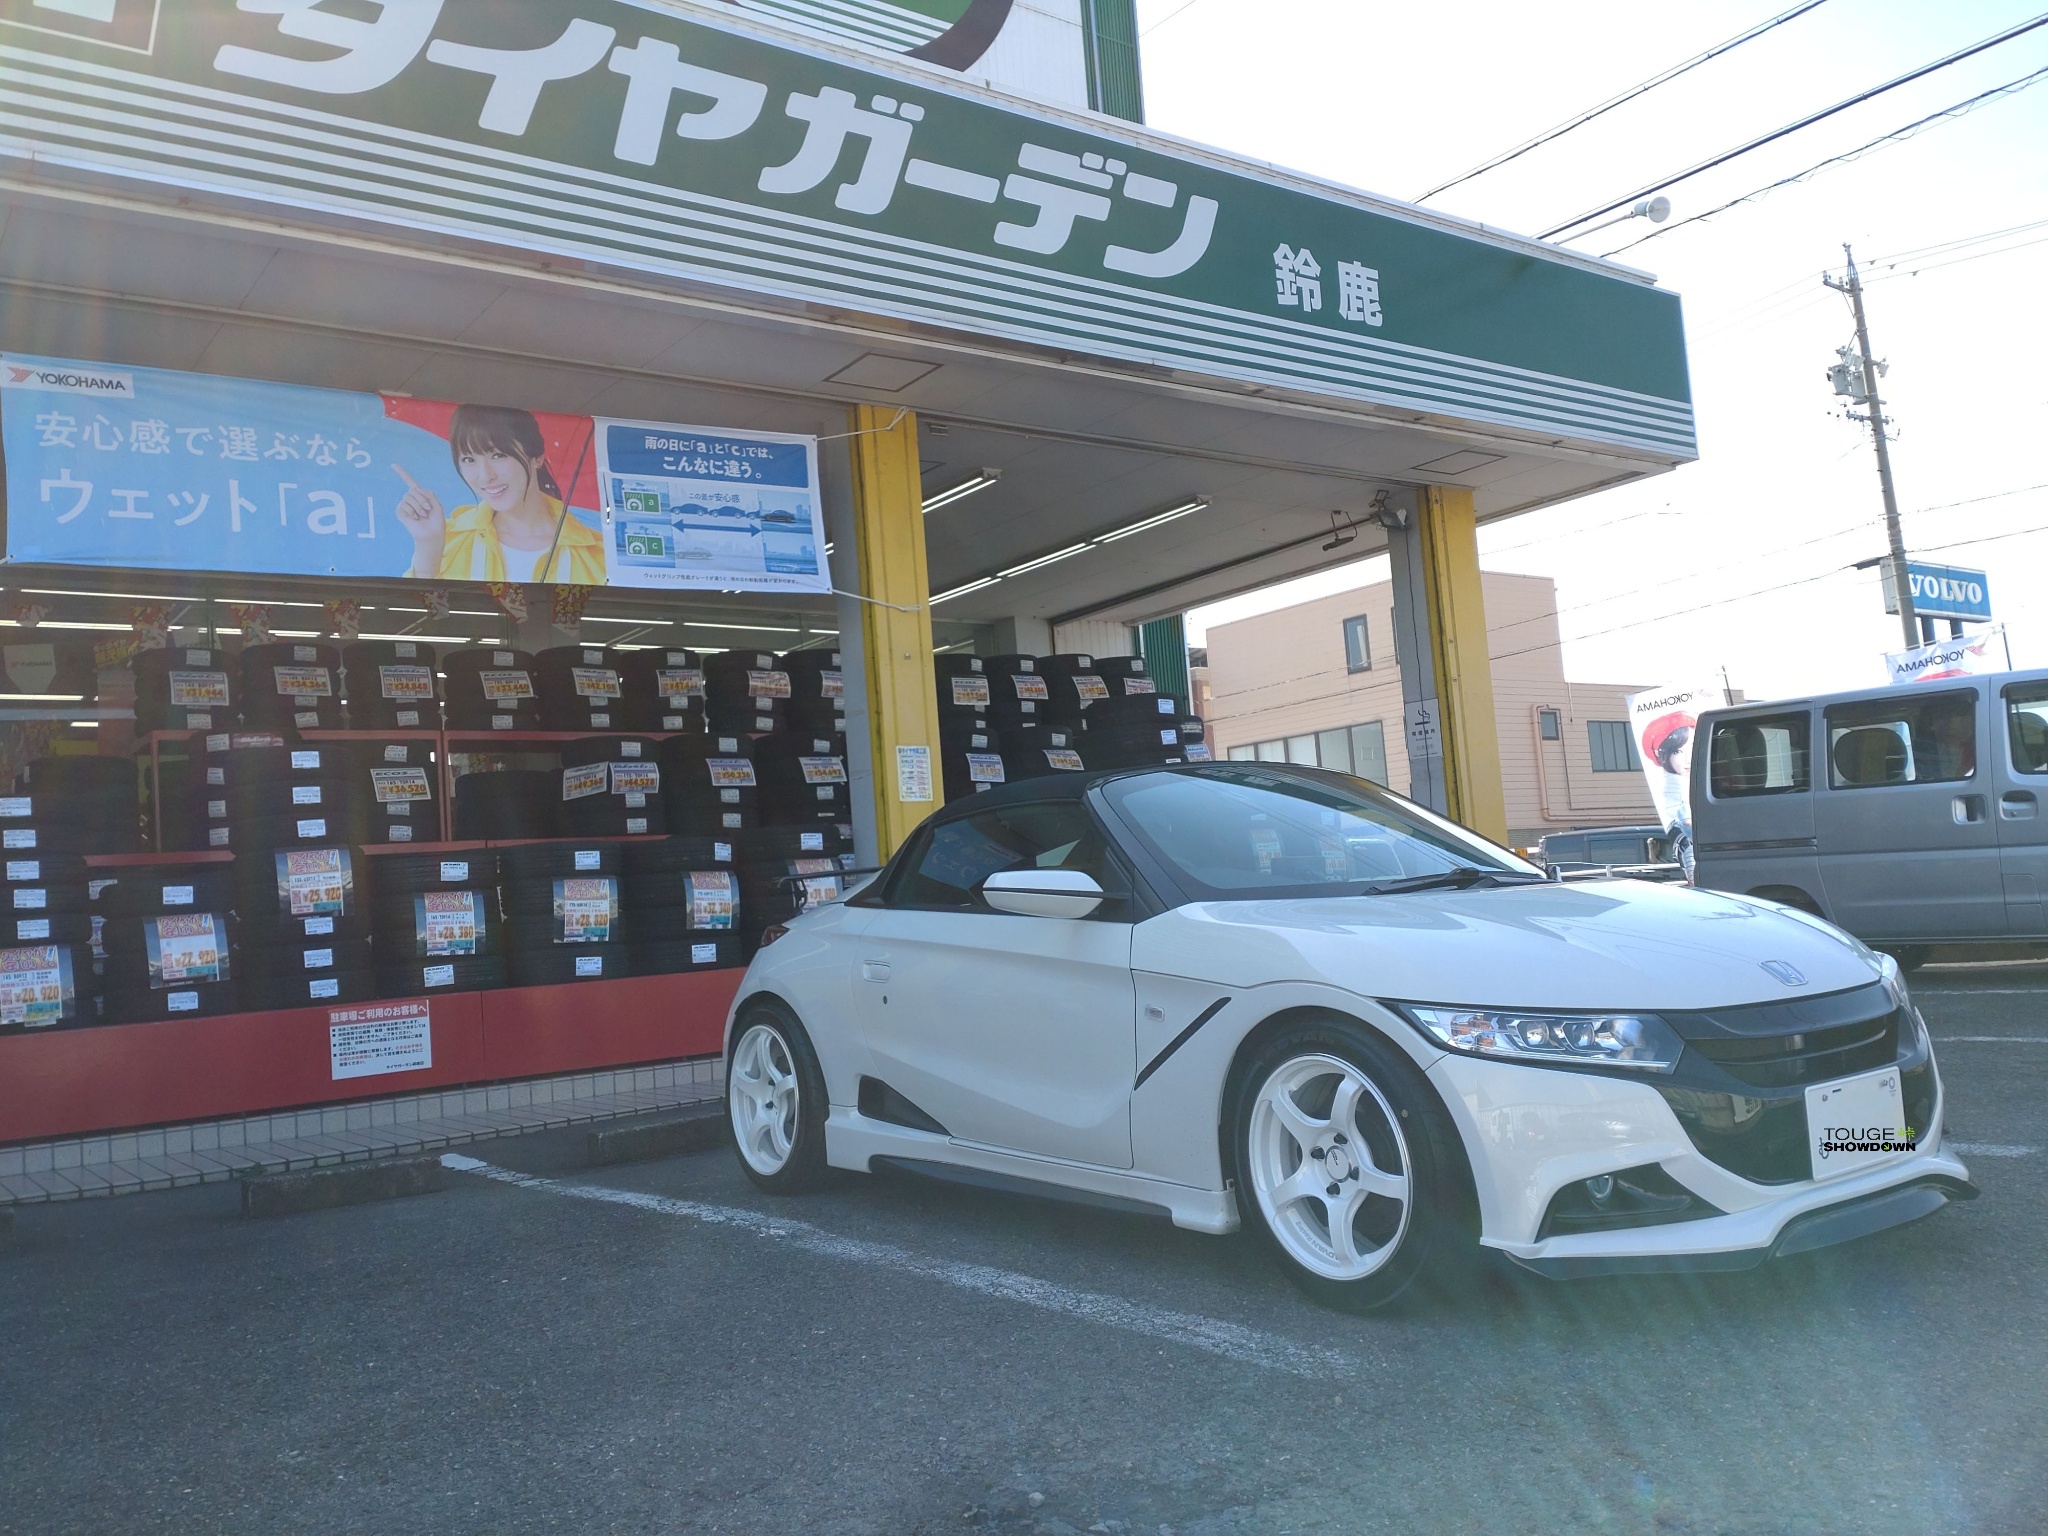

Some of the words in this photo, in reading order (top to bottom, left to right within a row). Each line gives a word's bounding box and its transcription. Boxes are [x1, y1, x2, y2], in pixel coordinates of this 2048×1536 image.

[1273, 243, 1383, 327] 鈴鹿
[36, 371, 126, 391] YOKOHAMA
[35, 410, 373, 469] 安心感で選ぶなら
[662, 456, 762, 480] こんなに違う。
[39, 467, 376, 540] ウェット「a」
[1908, 573, 1983, 606] VOLVO
[303, 887, 341, 903] ¥25,920
[438, 925, 474, 940] ¥28,380
[14, 985, 60, 1003] ¥20,920
[330, 1004, 427, 1023] 駐車場ご利用のお客様へ
